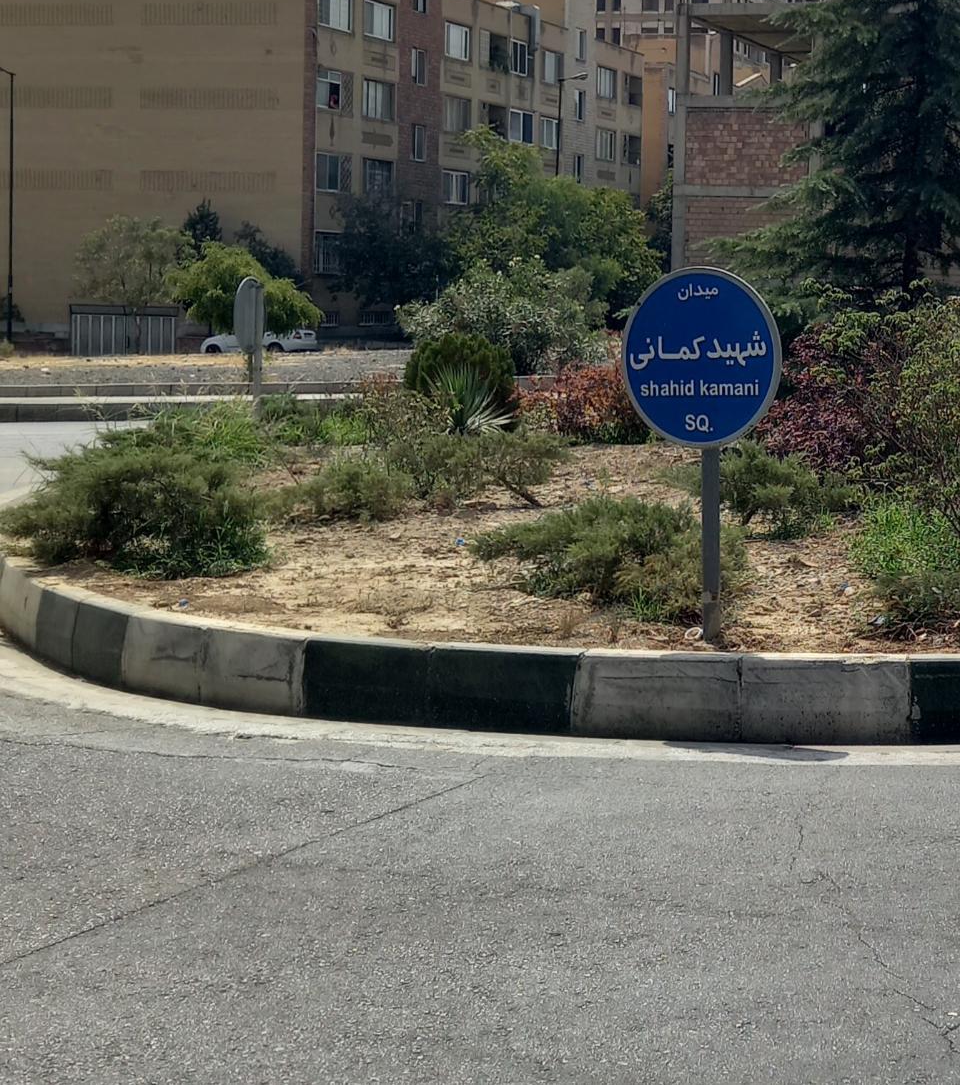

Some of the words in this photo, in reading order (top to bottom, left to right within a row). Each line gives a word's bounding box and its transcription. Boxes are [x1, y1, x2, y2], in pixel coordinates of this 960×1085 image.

[678, 283, 719, 301] میدان
[629, 336, 705, 370] کمانی
[706, 330, 767, 367] شهید
[640, 379, 695, 397] shahid
[700, 379, 759, 396] kamani
[685, 414, 714, 433] SQ.
